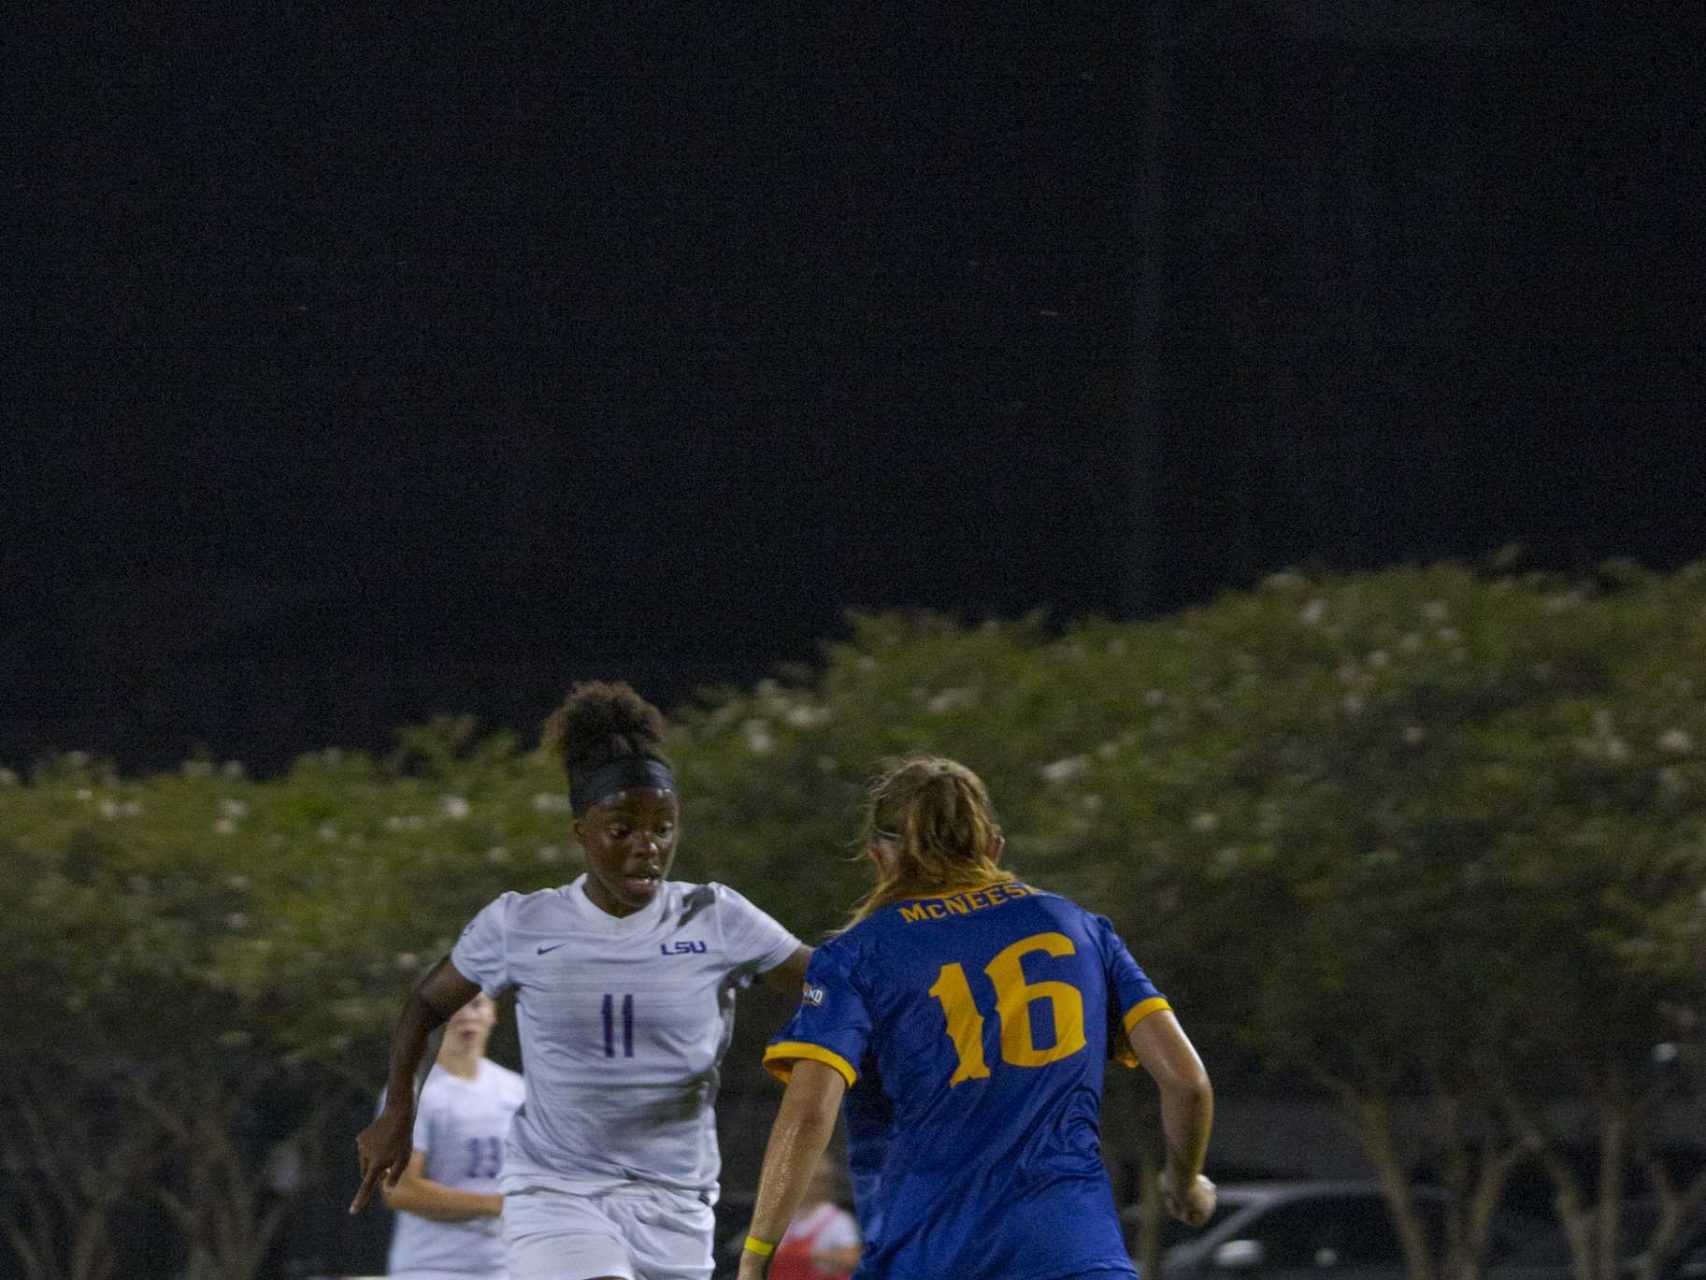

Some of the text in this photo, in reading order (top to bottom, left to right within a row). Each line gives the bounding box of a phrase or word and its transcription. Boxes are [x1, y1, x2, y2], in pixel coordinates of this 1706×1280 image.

[661, 940, 706, 956] LSU
[601, 993, 634, 1059] 11
[929, 932, 1087, 1088] 16
